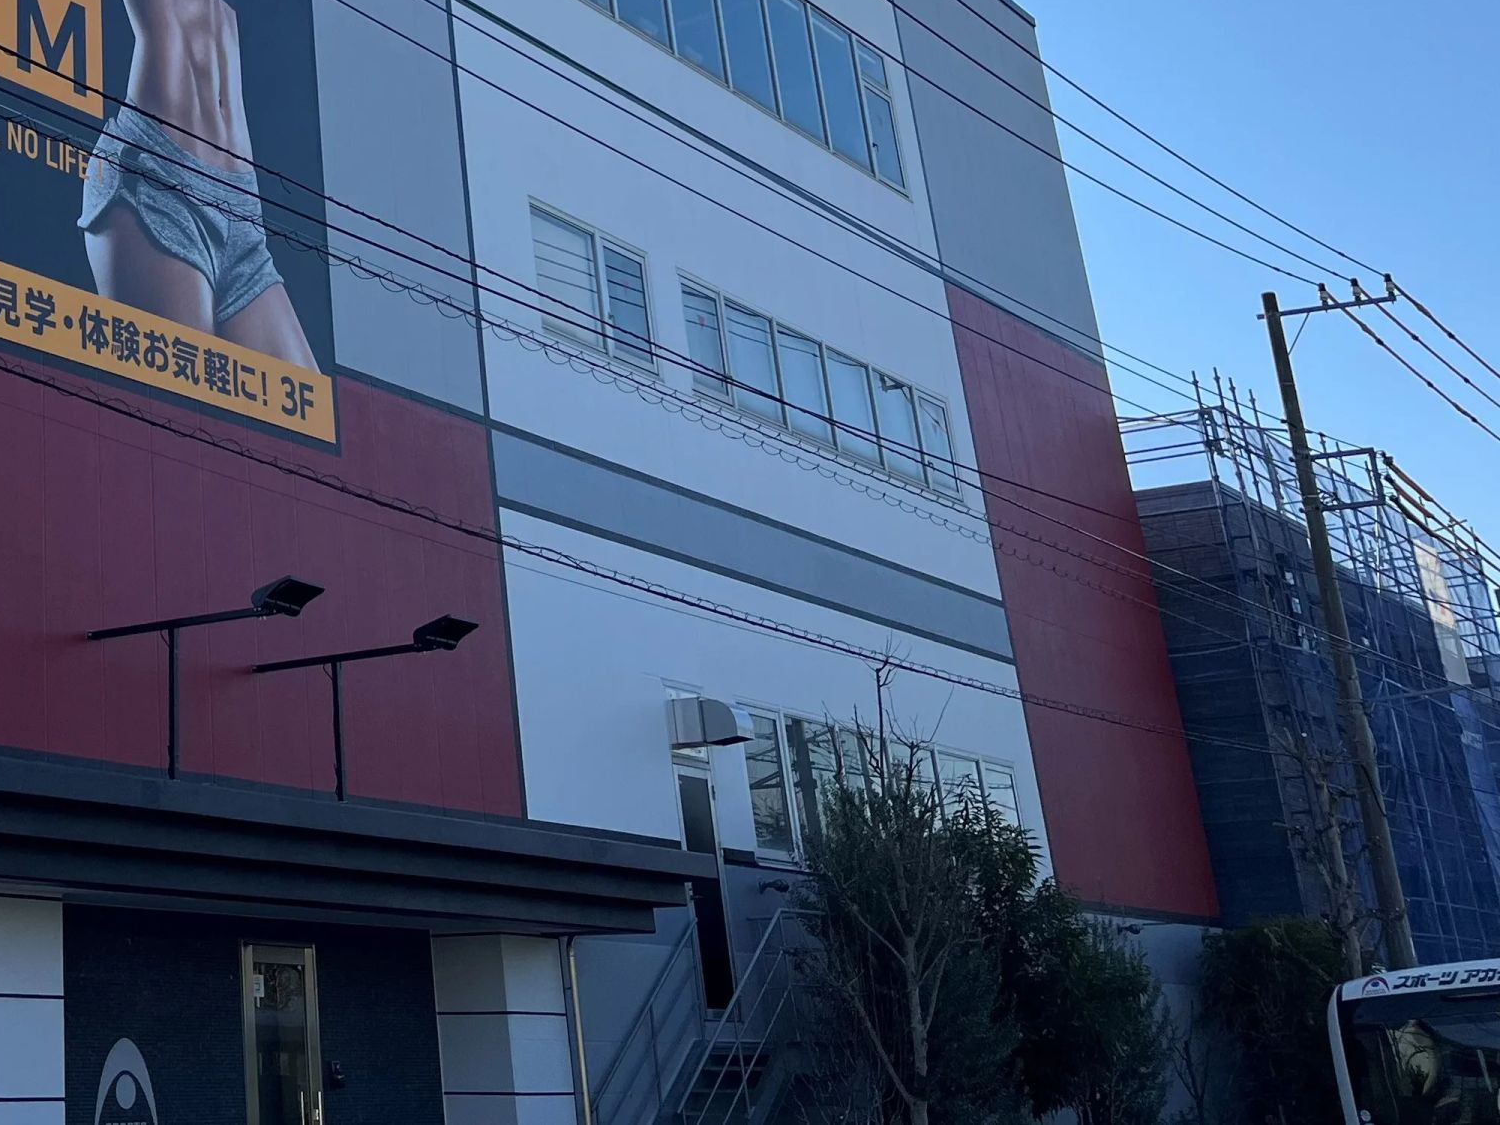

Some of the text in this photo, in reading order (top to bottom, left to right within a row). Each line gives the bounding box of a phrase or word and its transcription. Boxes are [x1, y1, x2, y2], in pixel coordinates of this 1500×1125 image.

[7, 121, 39, 160] NO
[281, 375, 315, 421] 3F
[1392, 968, 1500, 990] スポーツ アカ
